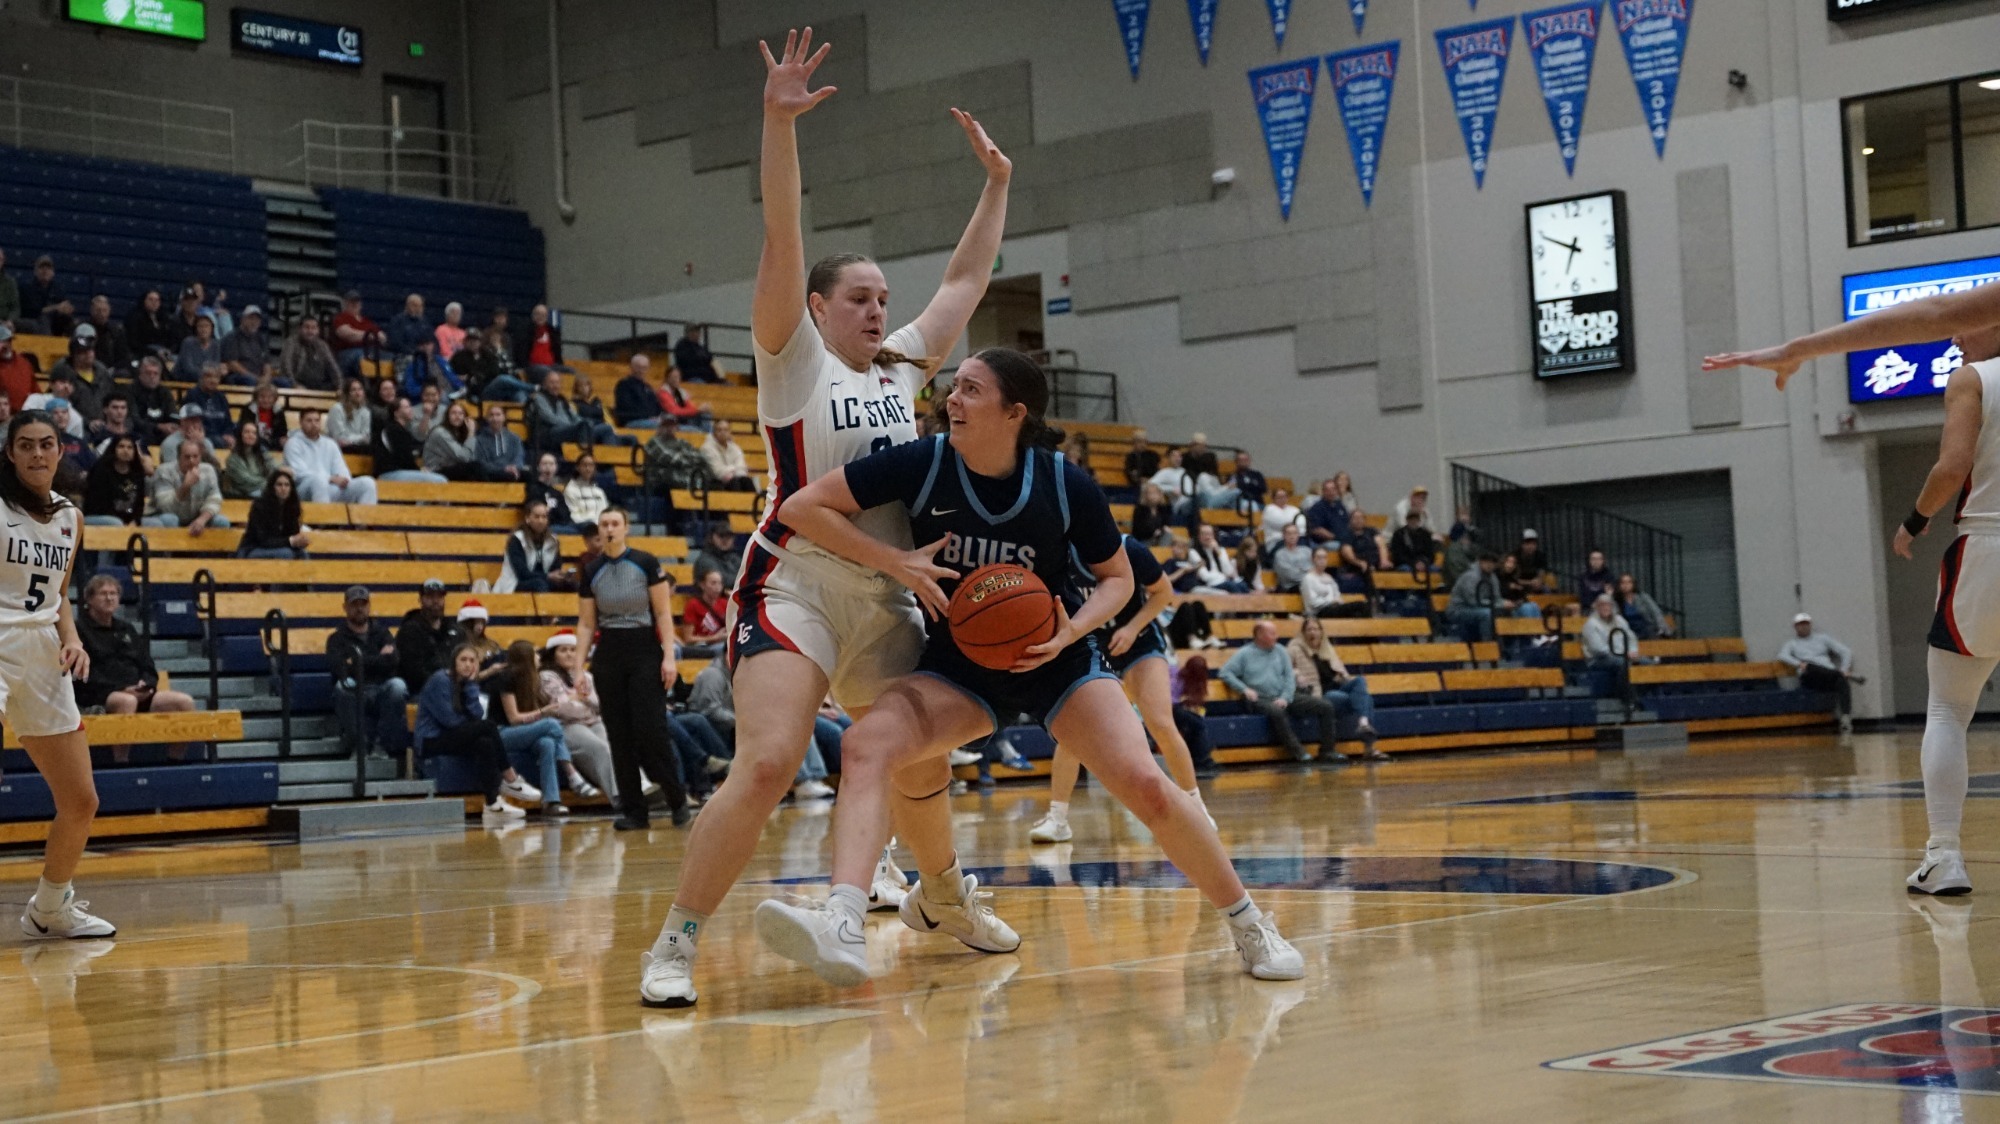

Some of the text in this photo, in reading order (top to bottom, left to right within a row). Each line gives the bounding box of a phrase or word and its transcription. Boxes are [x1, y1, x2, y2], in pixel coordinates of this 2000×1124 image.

[241, 22, 297, 42] CENTURY
[298, 32, 311, 46] 21
[1533, 10, 1593, 41] NAIA
[1447, 30, 1505, 60] NAIA
[1563, 202, 1581, 218] 12
[1535, 245, 1545, 260] 9
[1605, 234, 1615, 249] 3
[1571, 278, 1581, 293] 6
[1538, 300, 1574, 320] THE
[1569, 327, 1619, 349] SHOP
[830, 394, 911, 432] LC STATE
[6, 537, 72, 572] LC STATE
[943, 530, 1037, 573] BLUES
[24, 573, 50, 613] 5
[965, 571, 1024, 600] LEGACY
[1587, 1004, 1942, 1070] CASCADE
